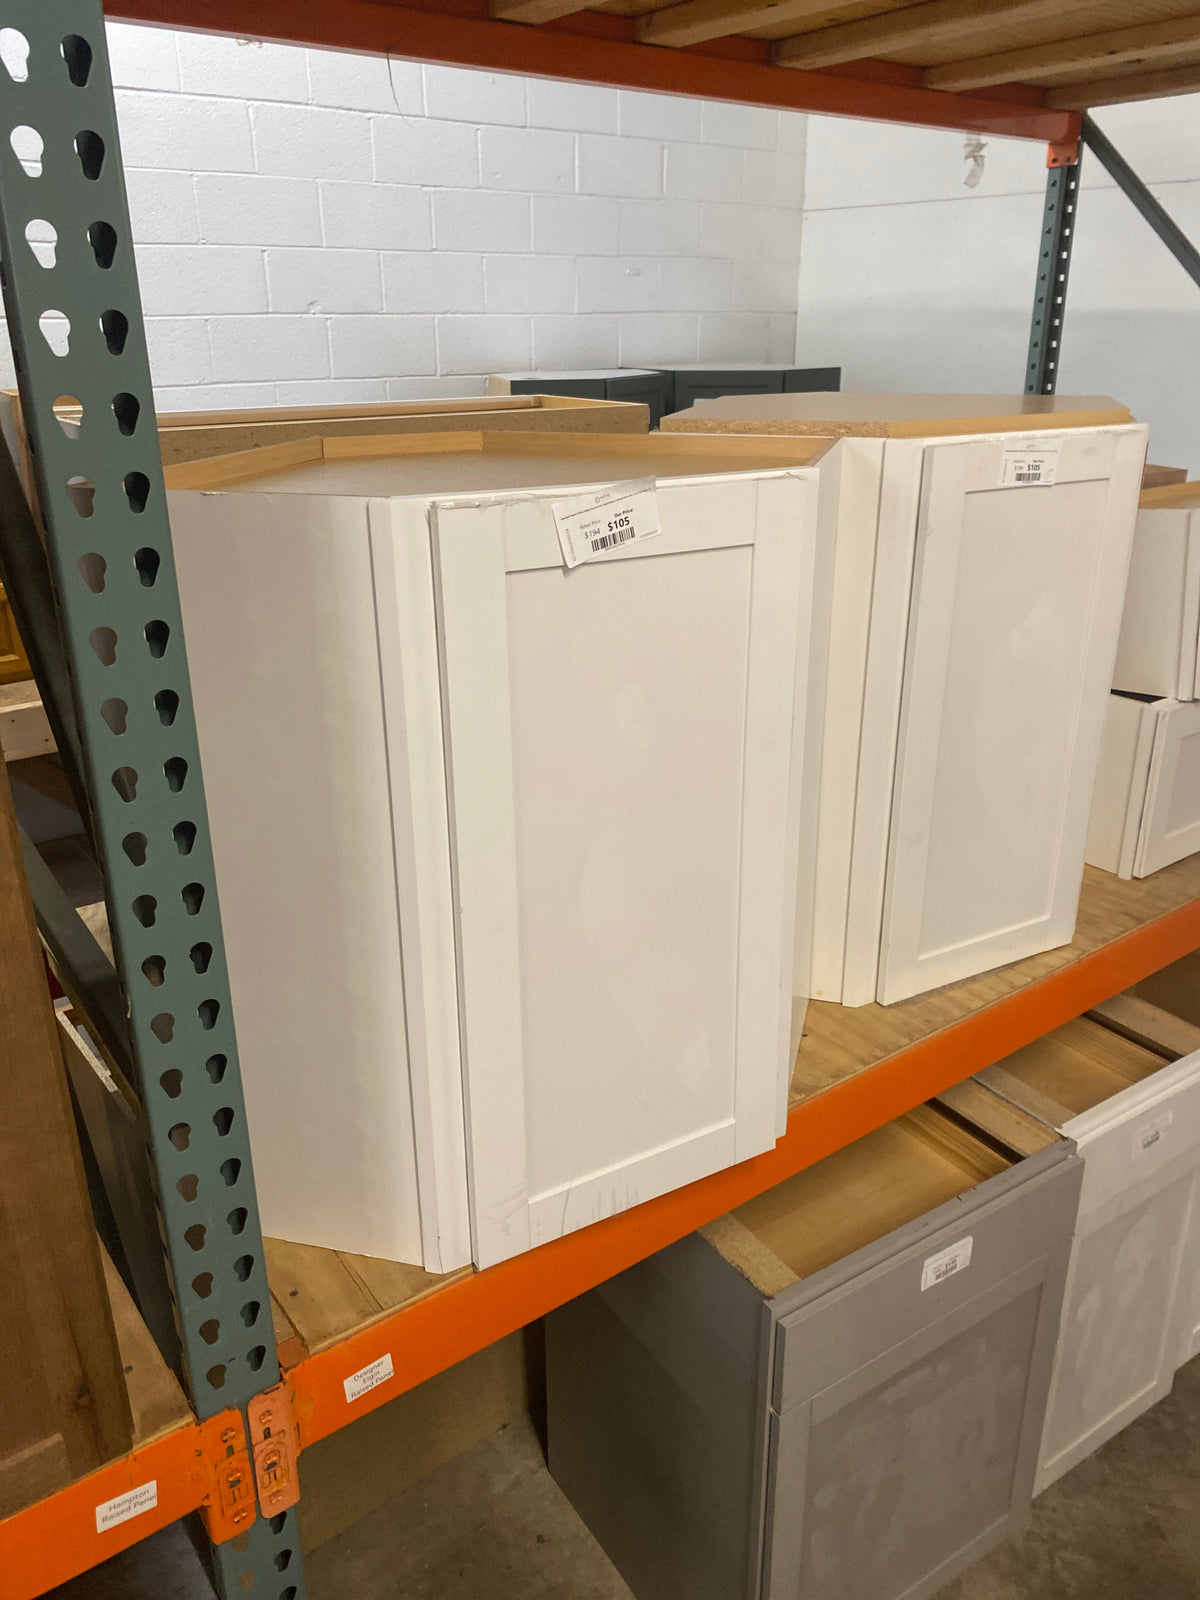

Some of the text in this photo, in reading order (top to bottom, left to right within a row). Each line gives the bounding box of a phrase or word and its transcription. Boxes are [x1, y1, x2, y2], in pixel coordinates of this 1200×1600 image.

[584, 528, 601, 540] $194
[607, 516, 630, 532] $105
[353, 1360, 384, 1382] Designer
[362, 1370, 381, 1384] Elgin
[351, 1368, 394, 1399] Raised Panel
[102, 1492, 157, 1523] Raised Panel
[109, 1489, 150, 1512] Hampton
